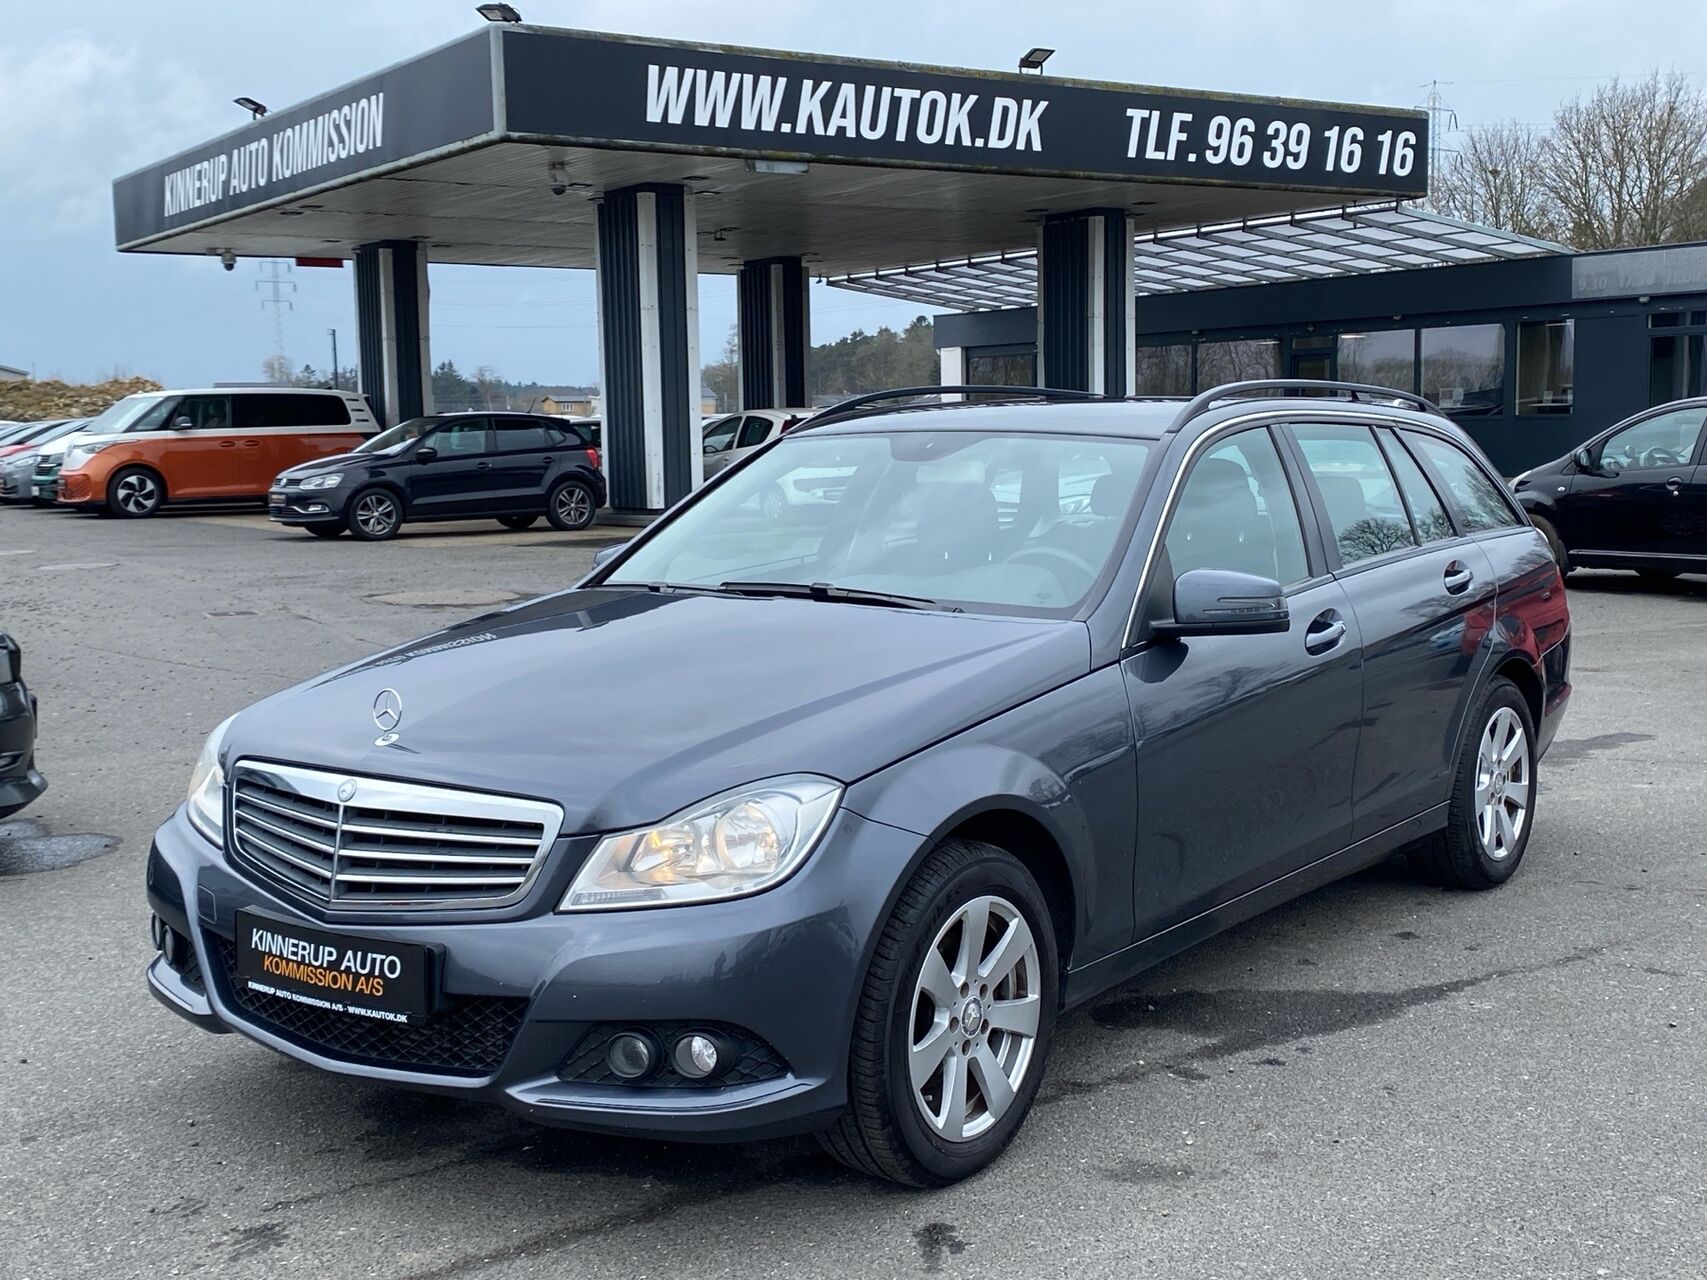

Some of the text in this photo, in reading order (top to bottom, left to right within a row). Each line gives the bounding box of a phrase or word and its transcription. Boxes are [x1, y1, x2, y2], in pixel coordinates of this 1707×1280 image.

[646, 64, 1049, 152] WWW.KAUTOK.DK
[165, 92, 384, 217] KINNERUP AUTO KOMMISSION
[1126, 108, 1417, 177] TLF. 96 39 16 16
[251, 928, 401, 979] KINNERUP AUTO
[263, 955, 384, 997] KOMMISSION A/S
[275, 989, 291, 1000] AUTO
[292, 993, 331, 1010] KOMMISSION
[331, 1002, 343, 1011] A/S
